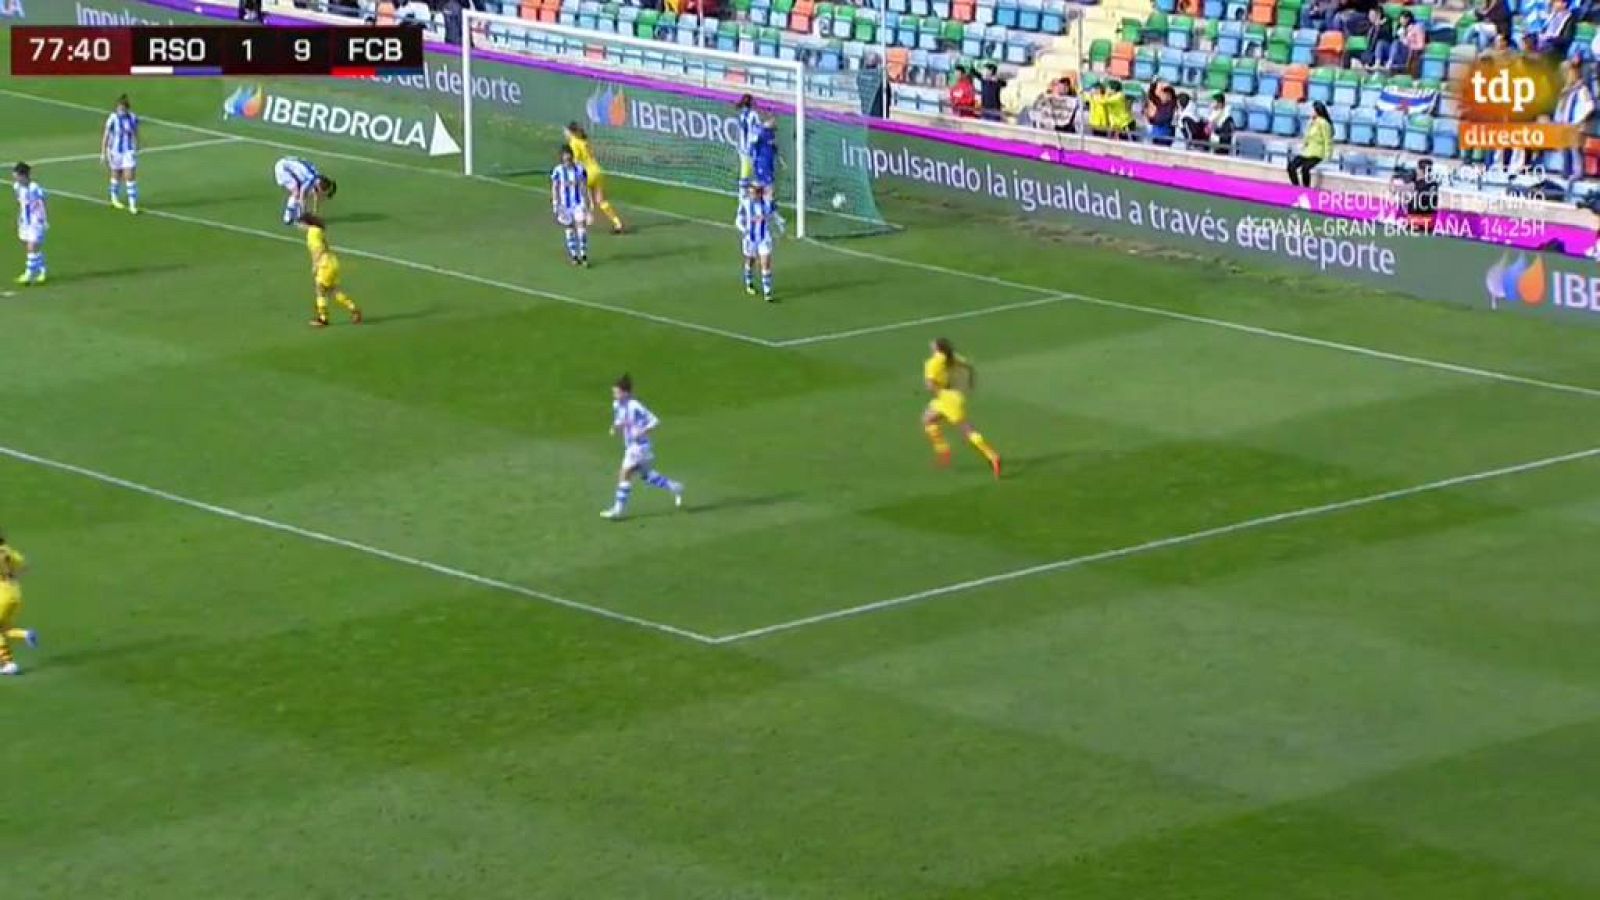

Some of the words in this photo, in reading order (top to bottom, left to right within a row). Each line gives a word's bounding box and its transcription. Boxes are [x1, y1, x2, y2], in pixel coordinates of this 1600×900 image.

[262, 95, 427, 151] IBERDROLA
[631, 99, 741, 147] IBERDRO
[841, 138, 980, 192] Impulsando
[986, 164, 1007, 199] la
[1012, 169, 1121, 220] igualdad
[1128, 200, 1143, 226] a
[1148, 200, 1230, 244] través
[1285, 226, 1396, 275] deporte
